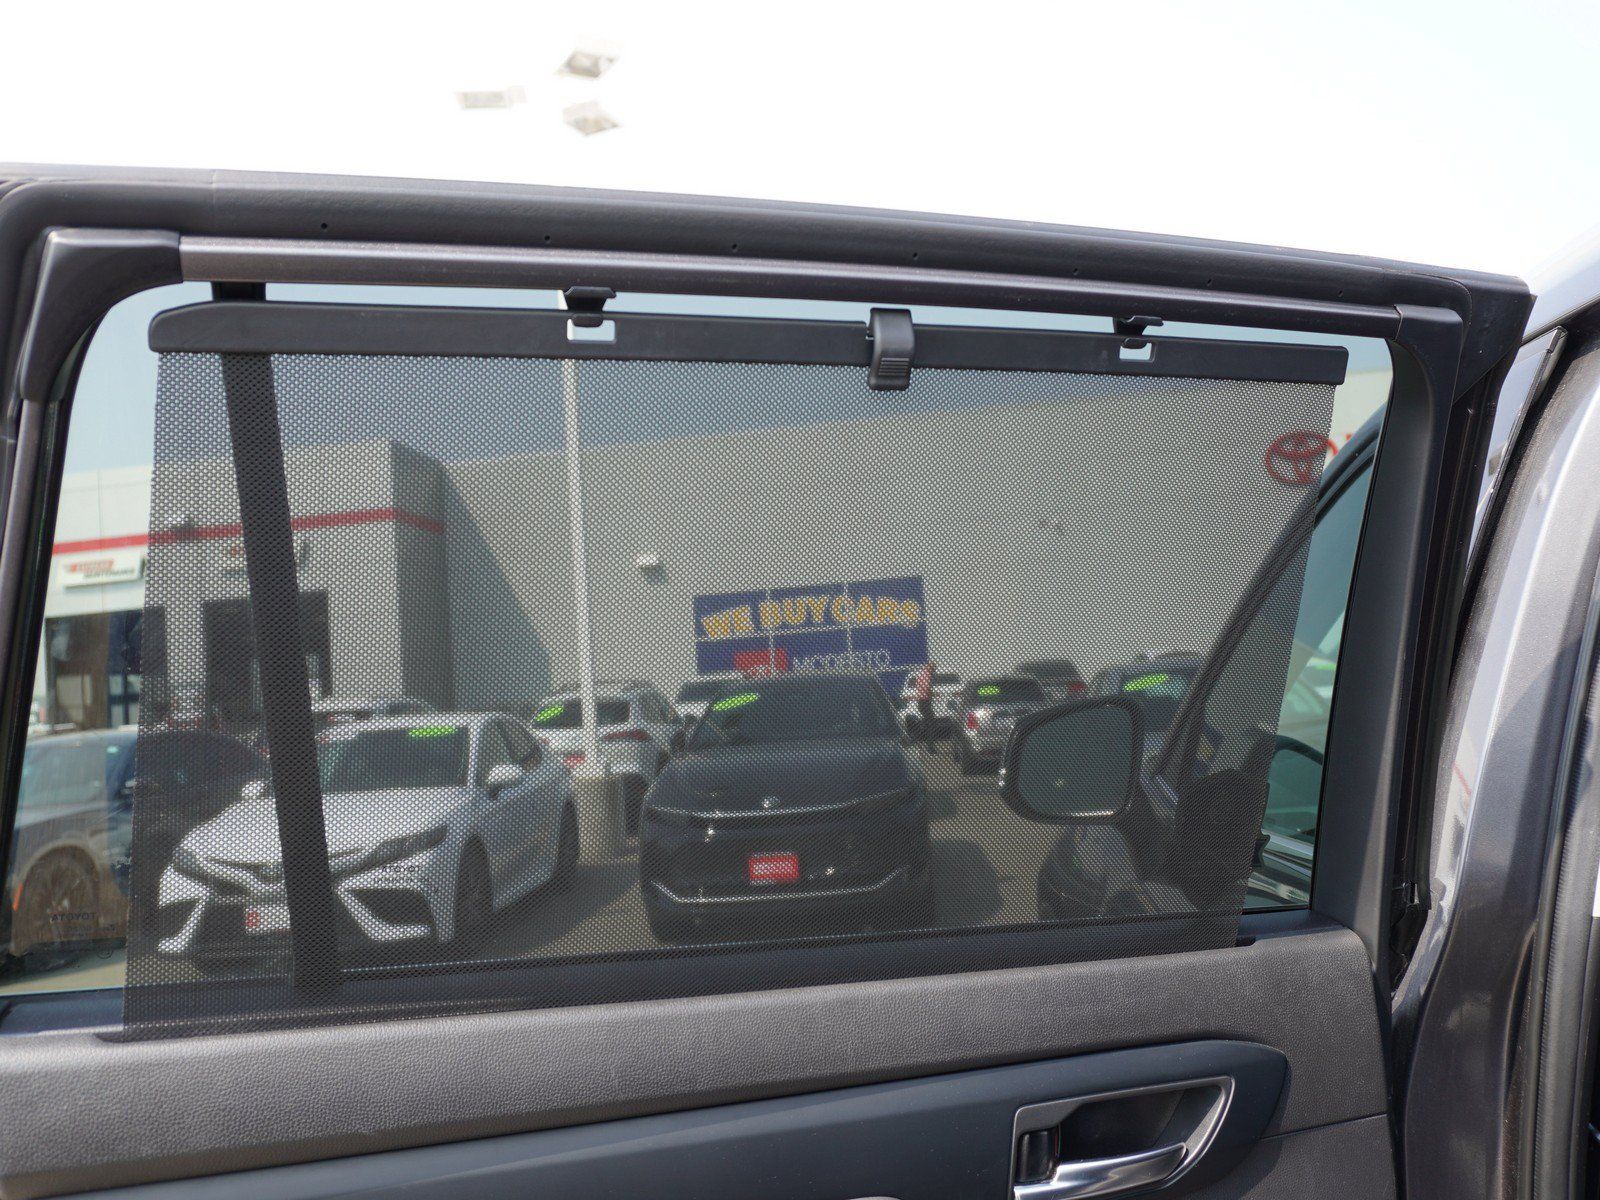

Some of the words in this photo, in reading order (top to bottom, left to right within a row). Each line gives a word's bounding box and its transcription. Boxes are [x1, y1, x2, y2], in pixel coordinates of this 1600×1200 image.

[703, 605, 753, 638] WE
[759, 596, 828, 627] BUY
[831, 595, 921, 629] CARS
[792, 649, 890, 672] MODESTO
